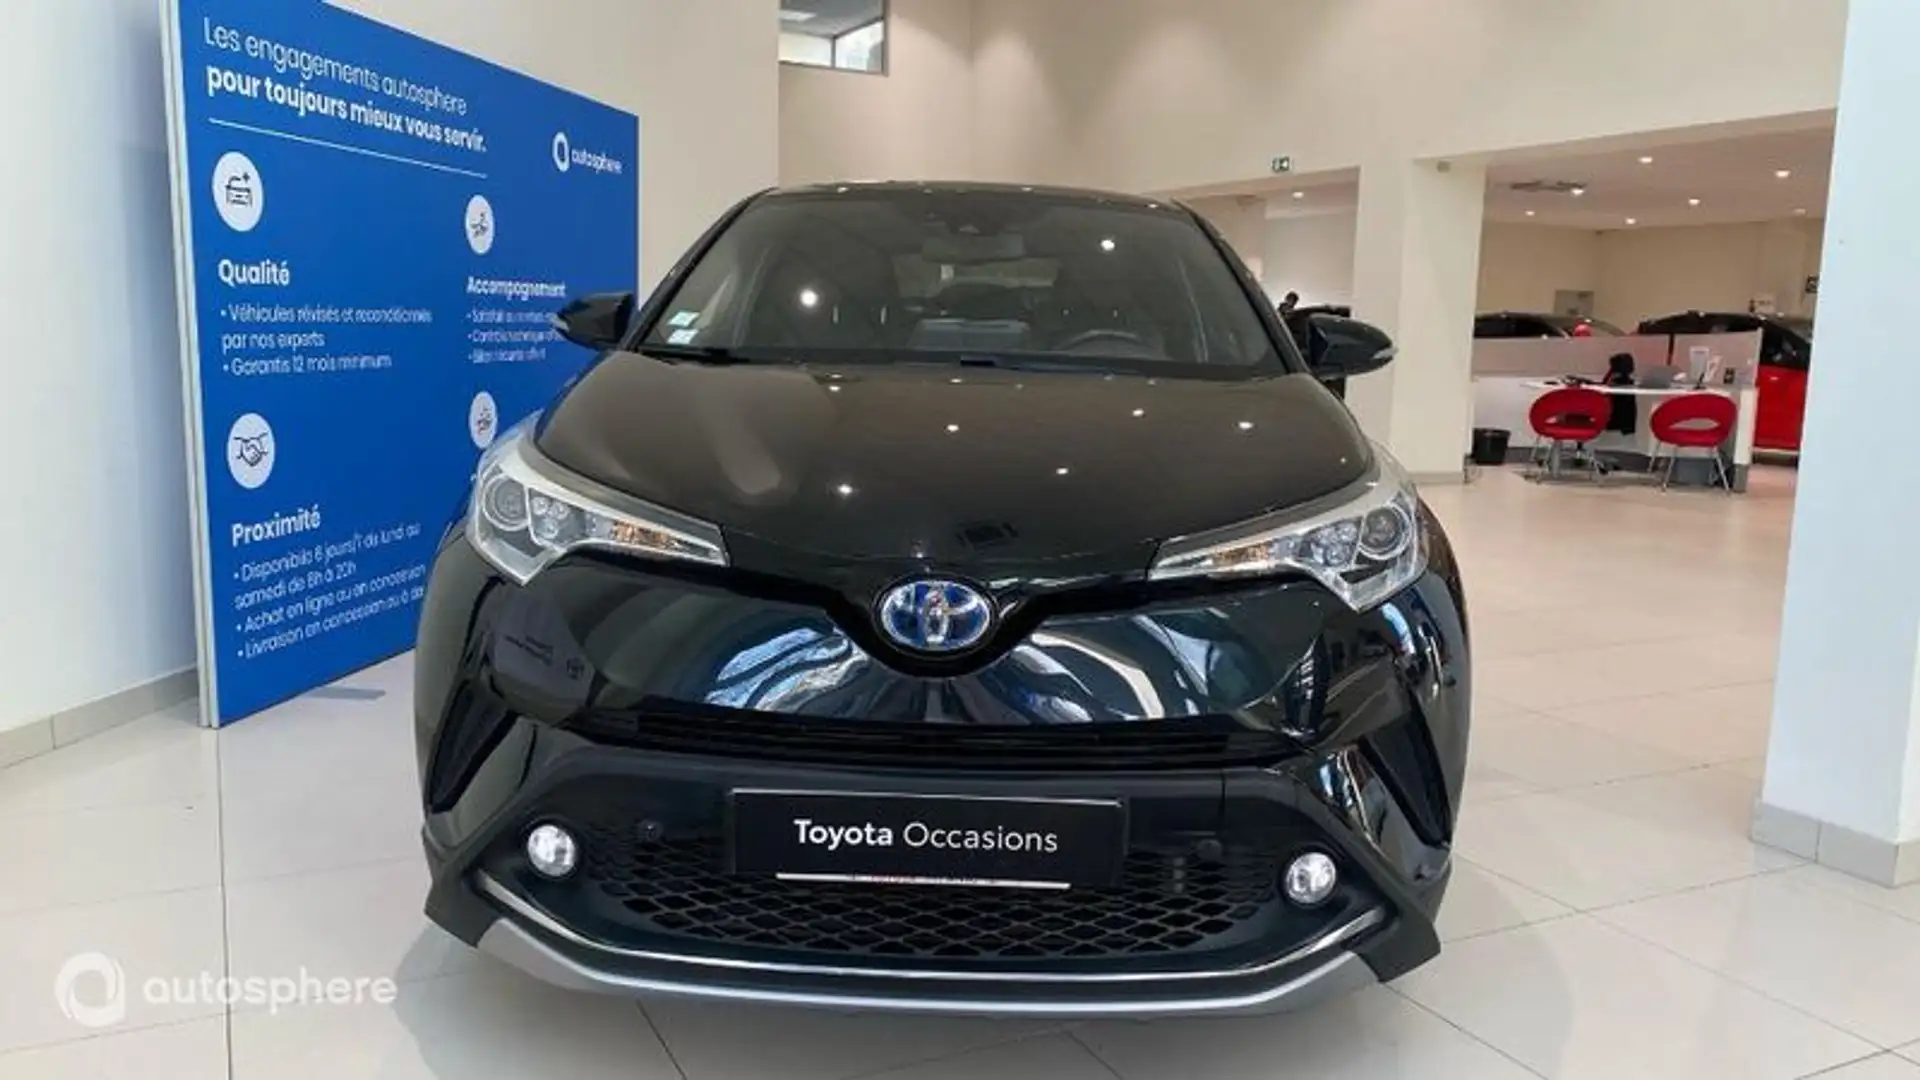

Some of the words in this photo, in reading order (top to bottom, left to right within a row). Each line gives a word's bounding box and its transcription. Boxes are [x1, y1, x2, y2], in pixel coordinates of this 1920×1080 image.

[204, 17, 240, 52] Les
[245, 35, 379, 92] engagements
[382, 76, 467, 116] autosphere
[206, 64, 261, 98] pour
[264, 76, 347, 119] toujours
[350, 100, 403, 133] mieux
[405, 116, 442, 142] vous
[218, 258, 290, 289] Qualité
[467, 276, 565, 301] Accompagnement
[228, 302, 296, 323] Véhicules
[221, 332, 247, 355] par
[250, 334, 275, 349] nos
[277, 332, 325, 352] experts
[293, 354, 304, 374] 12
[306, 353, 336, 371] mois
[232, 503, 321, 547] Proximité
[241, 548, 313, 583] Disponible
[234, 579, 287, 610] samedi
[244, 606, 284, 633] Achat
[305, 590, 335, 616] ligne
[244, 625, 303, 658] Livraison
[794, 818, 894, 850] Toyota
[903, 822, 1058, 853] Occasions
